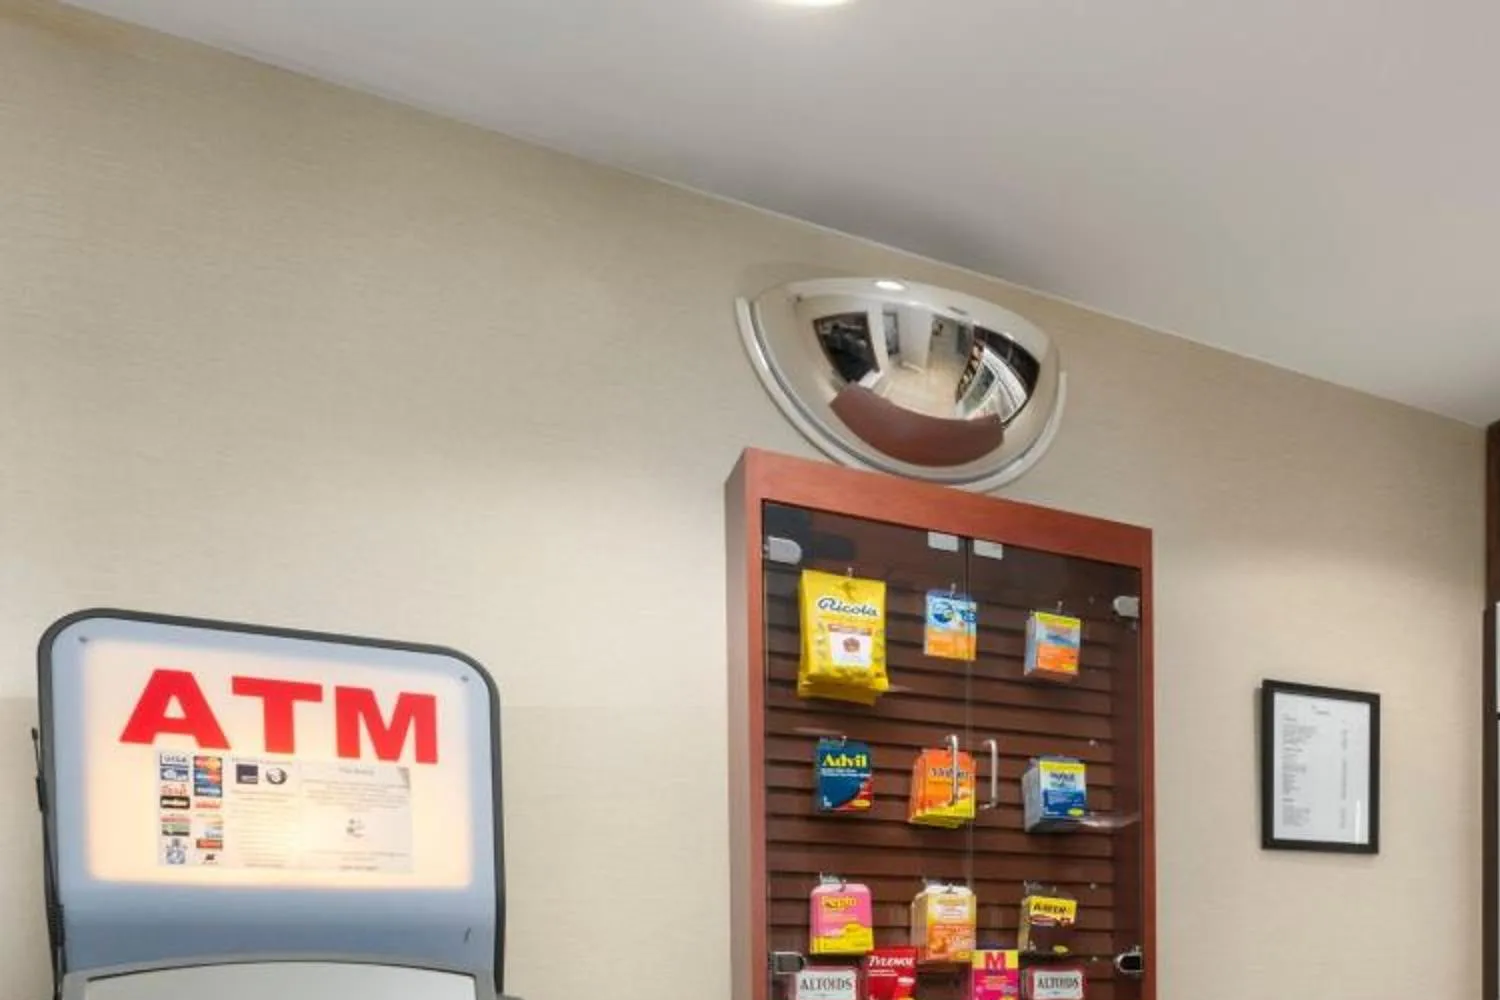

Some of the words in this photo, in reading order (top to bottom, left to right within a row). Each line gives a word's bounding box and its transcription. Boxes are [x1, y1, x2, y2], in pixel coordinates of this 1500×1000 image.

[817, 597, 878, 617] Ricola
[119, 668, 438, 765] ATM
[823, 753, 867, 769] Advil
[868, 955, 913, 968] TYLENOL
[800, 977, 853, 991] ALTOIDS
[1037, 976, 1080, 990] ALTOIDS
